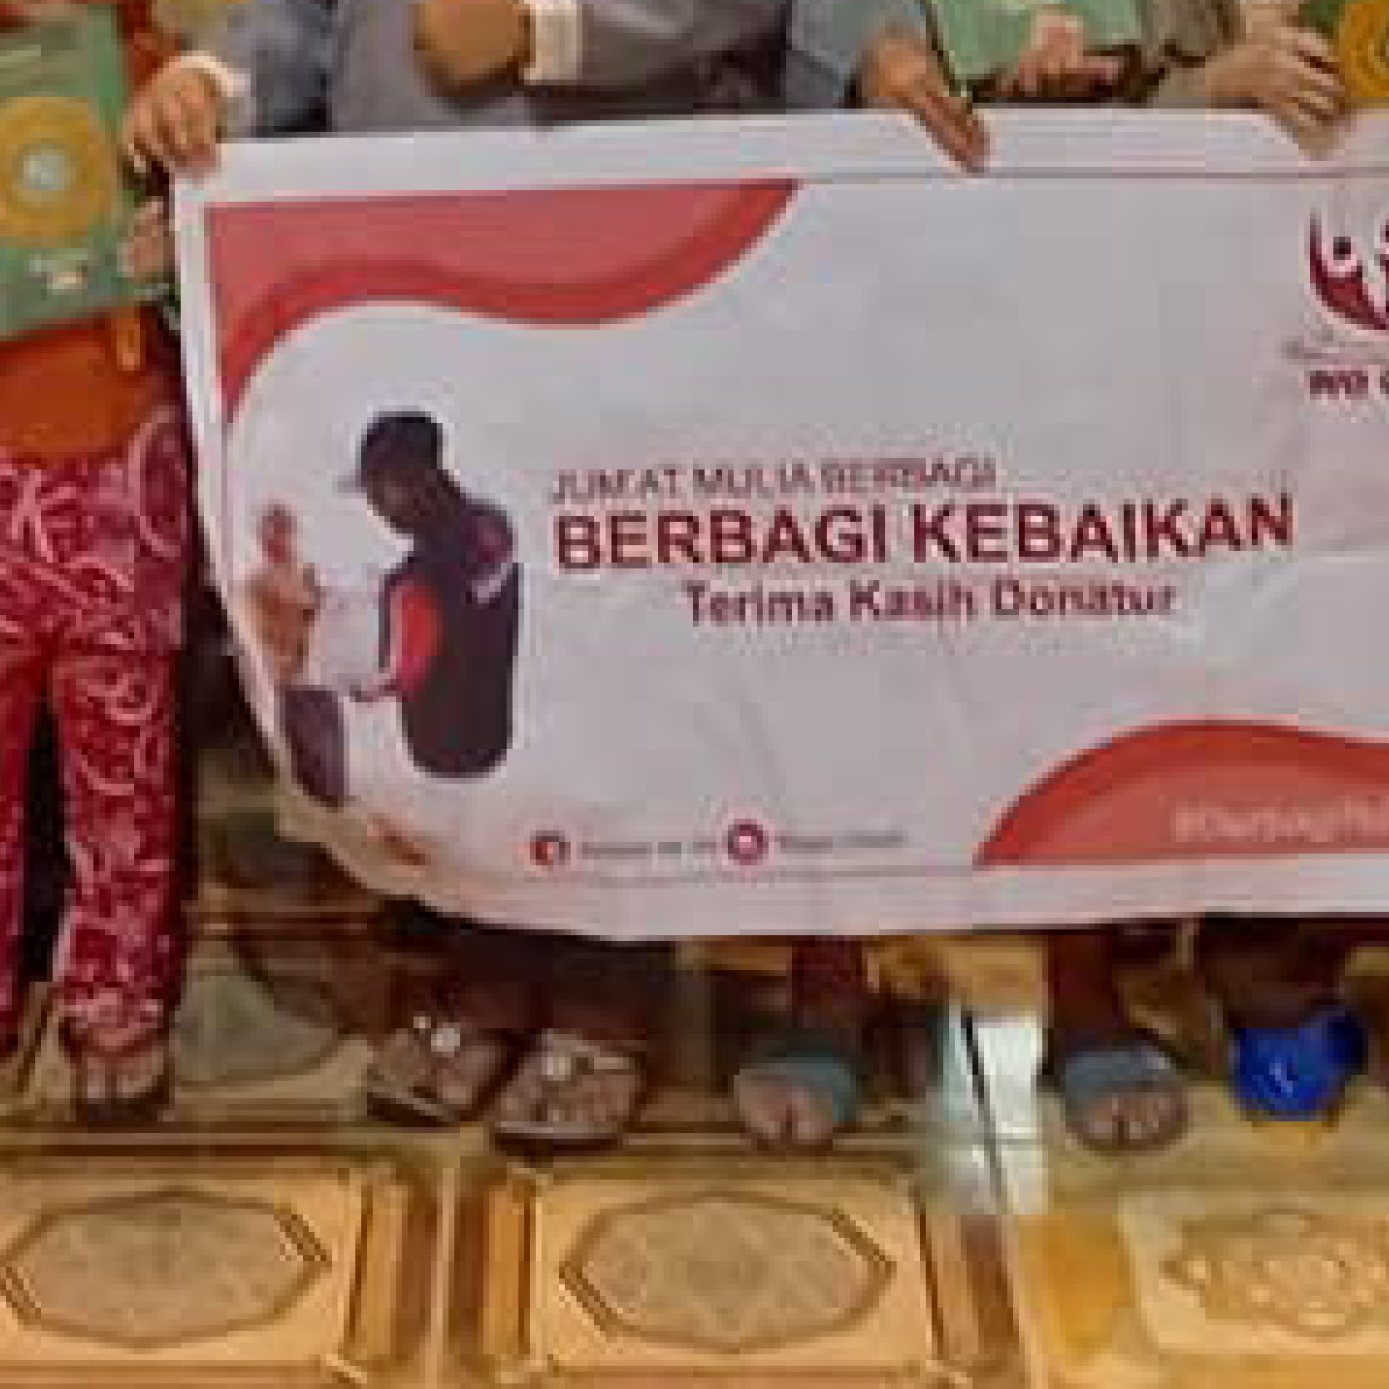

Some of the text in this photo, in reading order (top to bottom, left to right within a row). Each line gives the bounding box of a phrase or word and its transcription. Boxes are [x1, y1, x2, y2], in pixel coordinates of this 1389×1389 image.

[692, 457, 815, 501] MULIA
[820, 452, 998, 497] BERBAGI
[553, 491, 1296, 572] BERBAGI KEBAIKAN
[684, 572, 1176, 627] Terima Kasih Donatur
